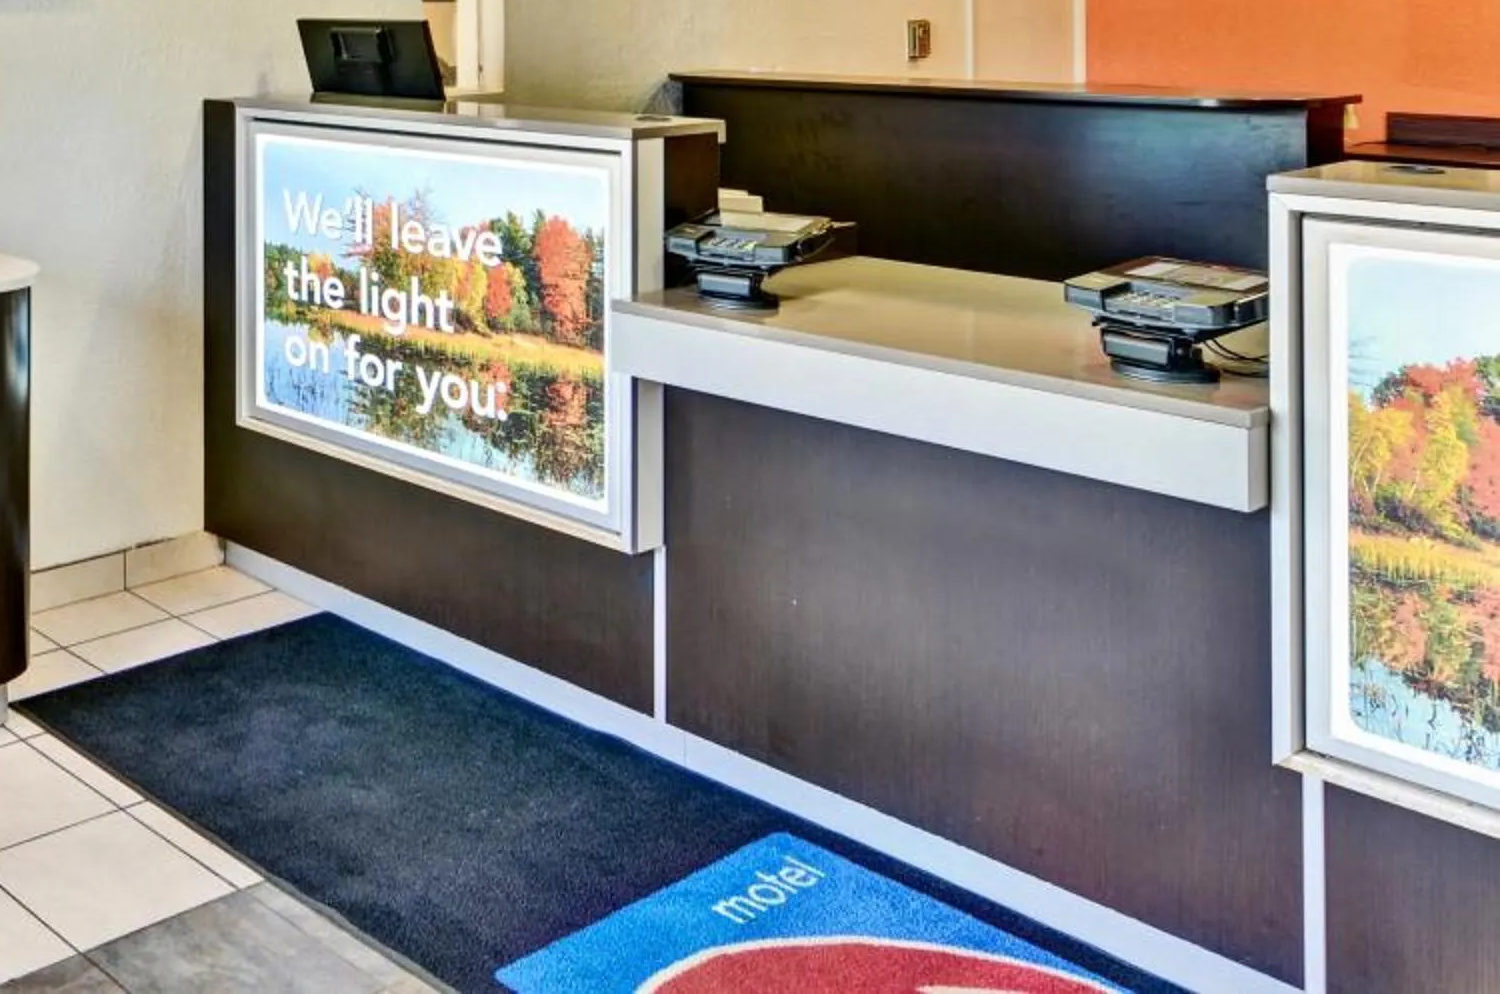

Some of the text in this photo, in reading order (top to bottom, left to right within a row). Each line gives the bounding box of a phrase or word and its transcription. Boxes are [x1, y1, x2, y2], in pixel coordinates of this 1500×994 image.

[283, 187, 503, 267] We'll leave
[284, 256, 456, 336] the light
[284, 332, 329, 374] on
[343, 334, 402, 393] for
[710, 855, 826, 925] motel
